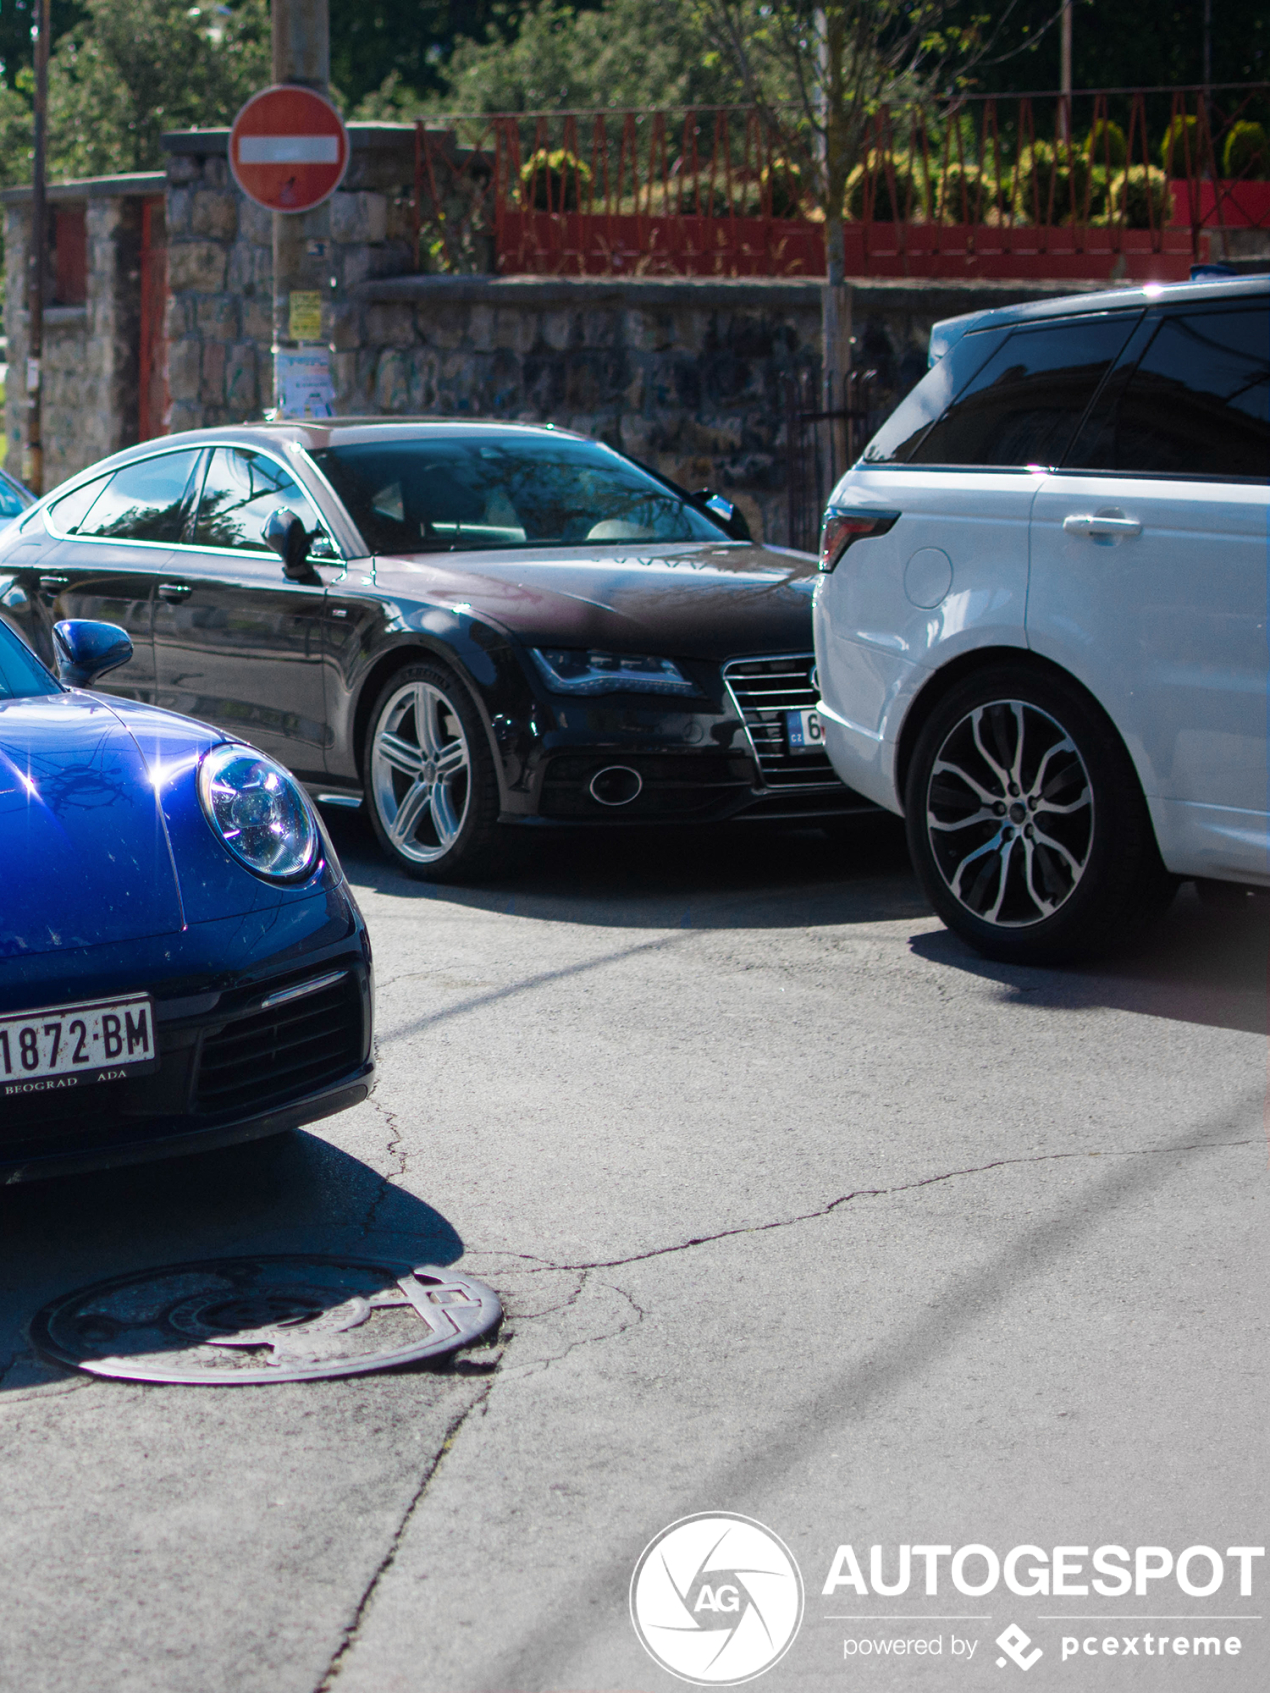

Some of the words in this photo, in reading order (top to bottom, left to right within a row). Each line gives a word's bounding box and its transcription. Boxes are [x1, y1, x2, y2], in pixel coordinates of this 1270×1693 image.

[791, 733, 802, 743] CZ
[5, 1077, 78, 1095] BEOGRAD
[97, 1070, 127, 1082] ADA
